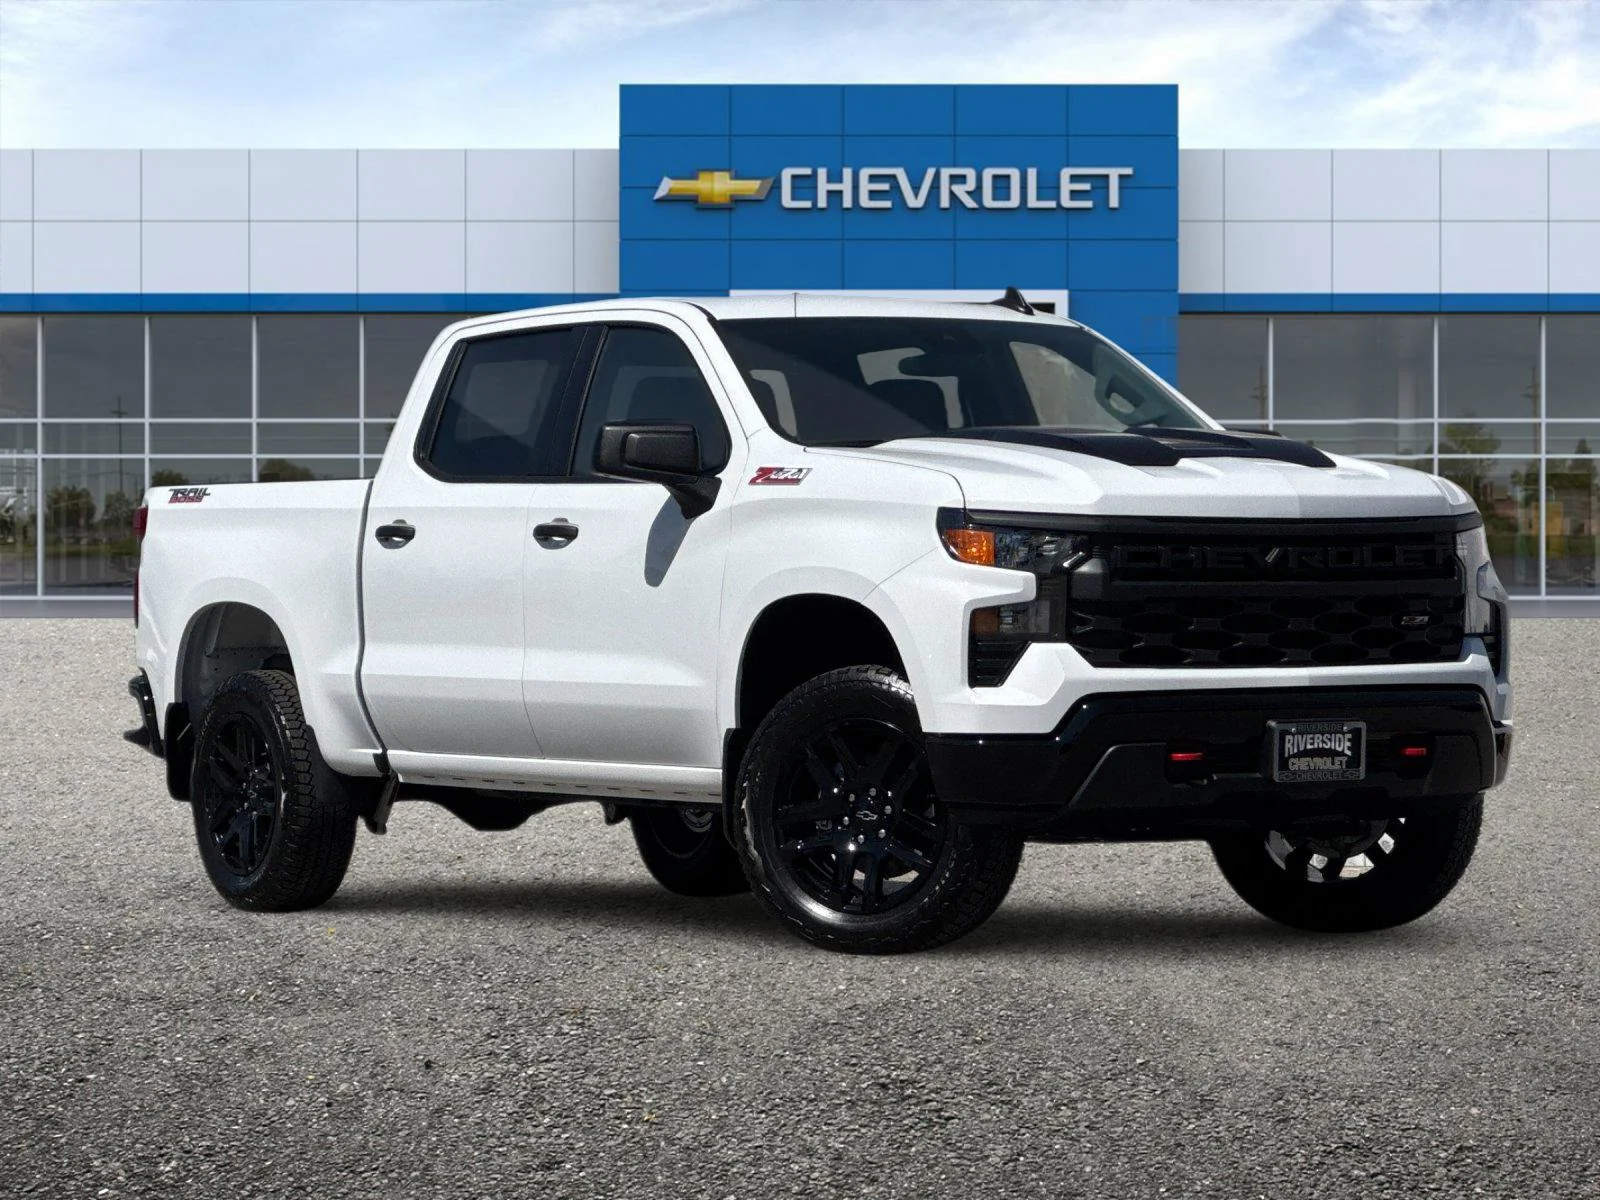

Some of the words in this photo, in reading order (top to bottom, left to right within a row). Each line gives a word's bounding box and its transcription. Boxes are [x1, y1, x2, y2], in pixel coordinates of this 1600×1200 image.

[780, 167, 1134, 209] CHEVROLET
[168, 487, 211, 497] TRAIL
[1117, 543, 1449, 571] CHEVROLET
[1284, 733, 1352, 757] RIVERSIDE
[1288, 756, 1348, 771] CHEVROLET
